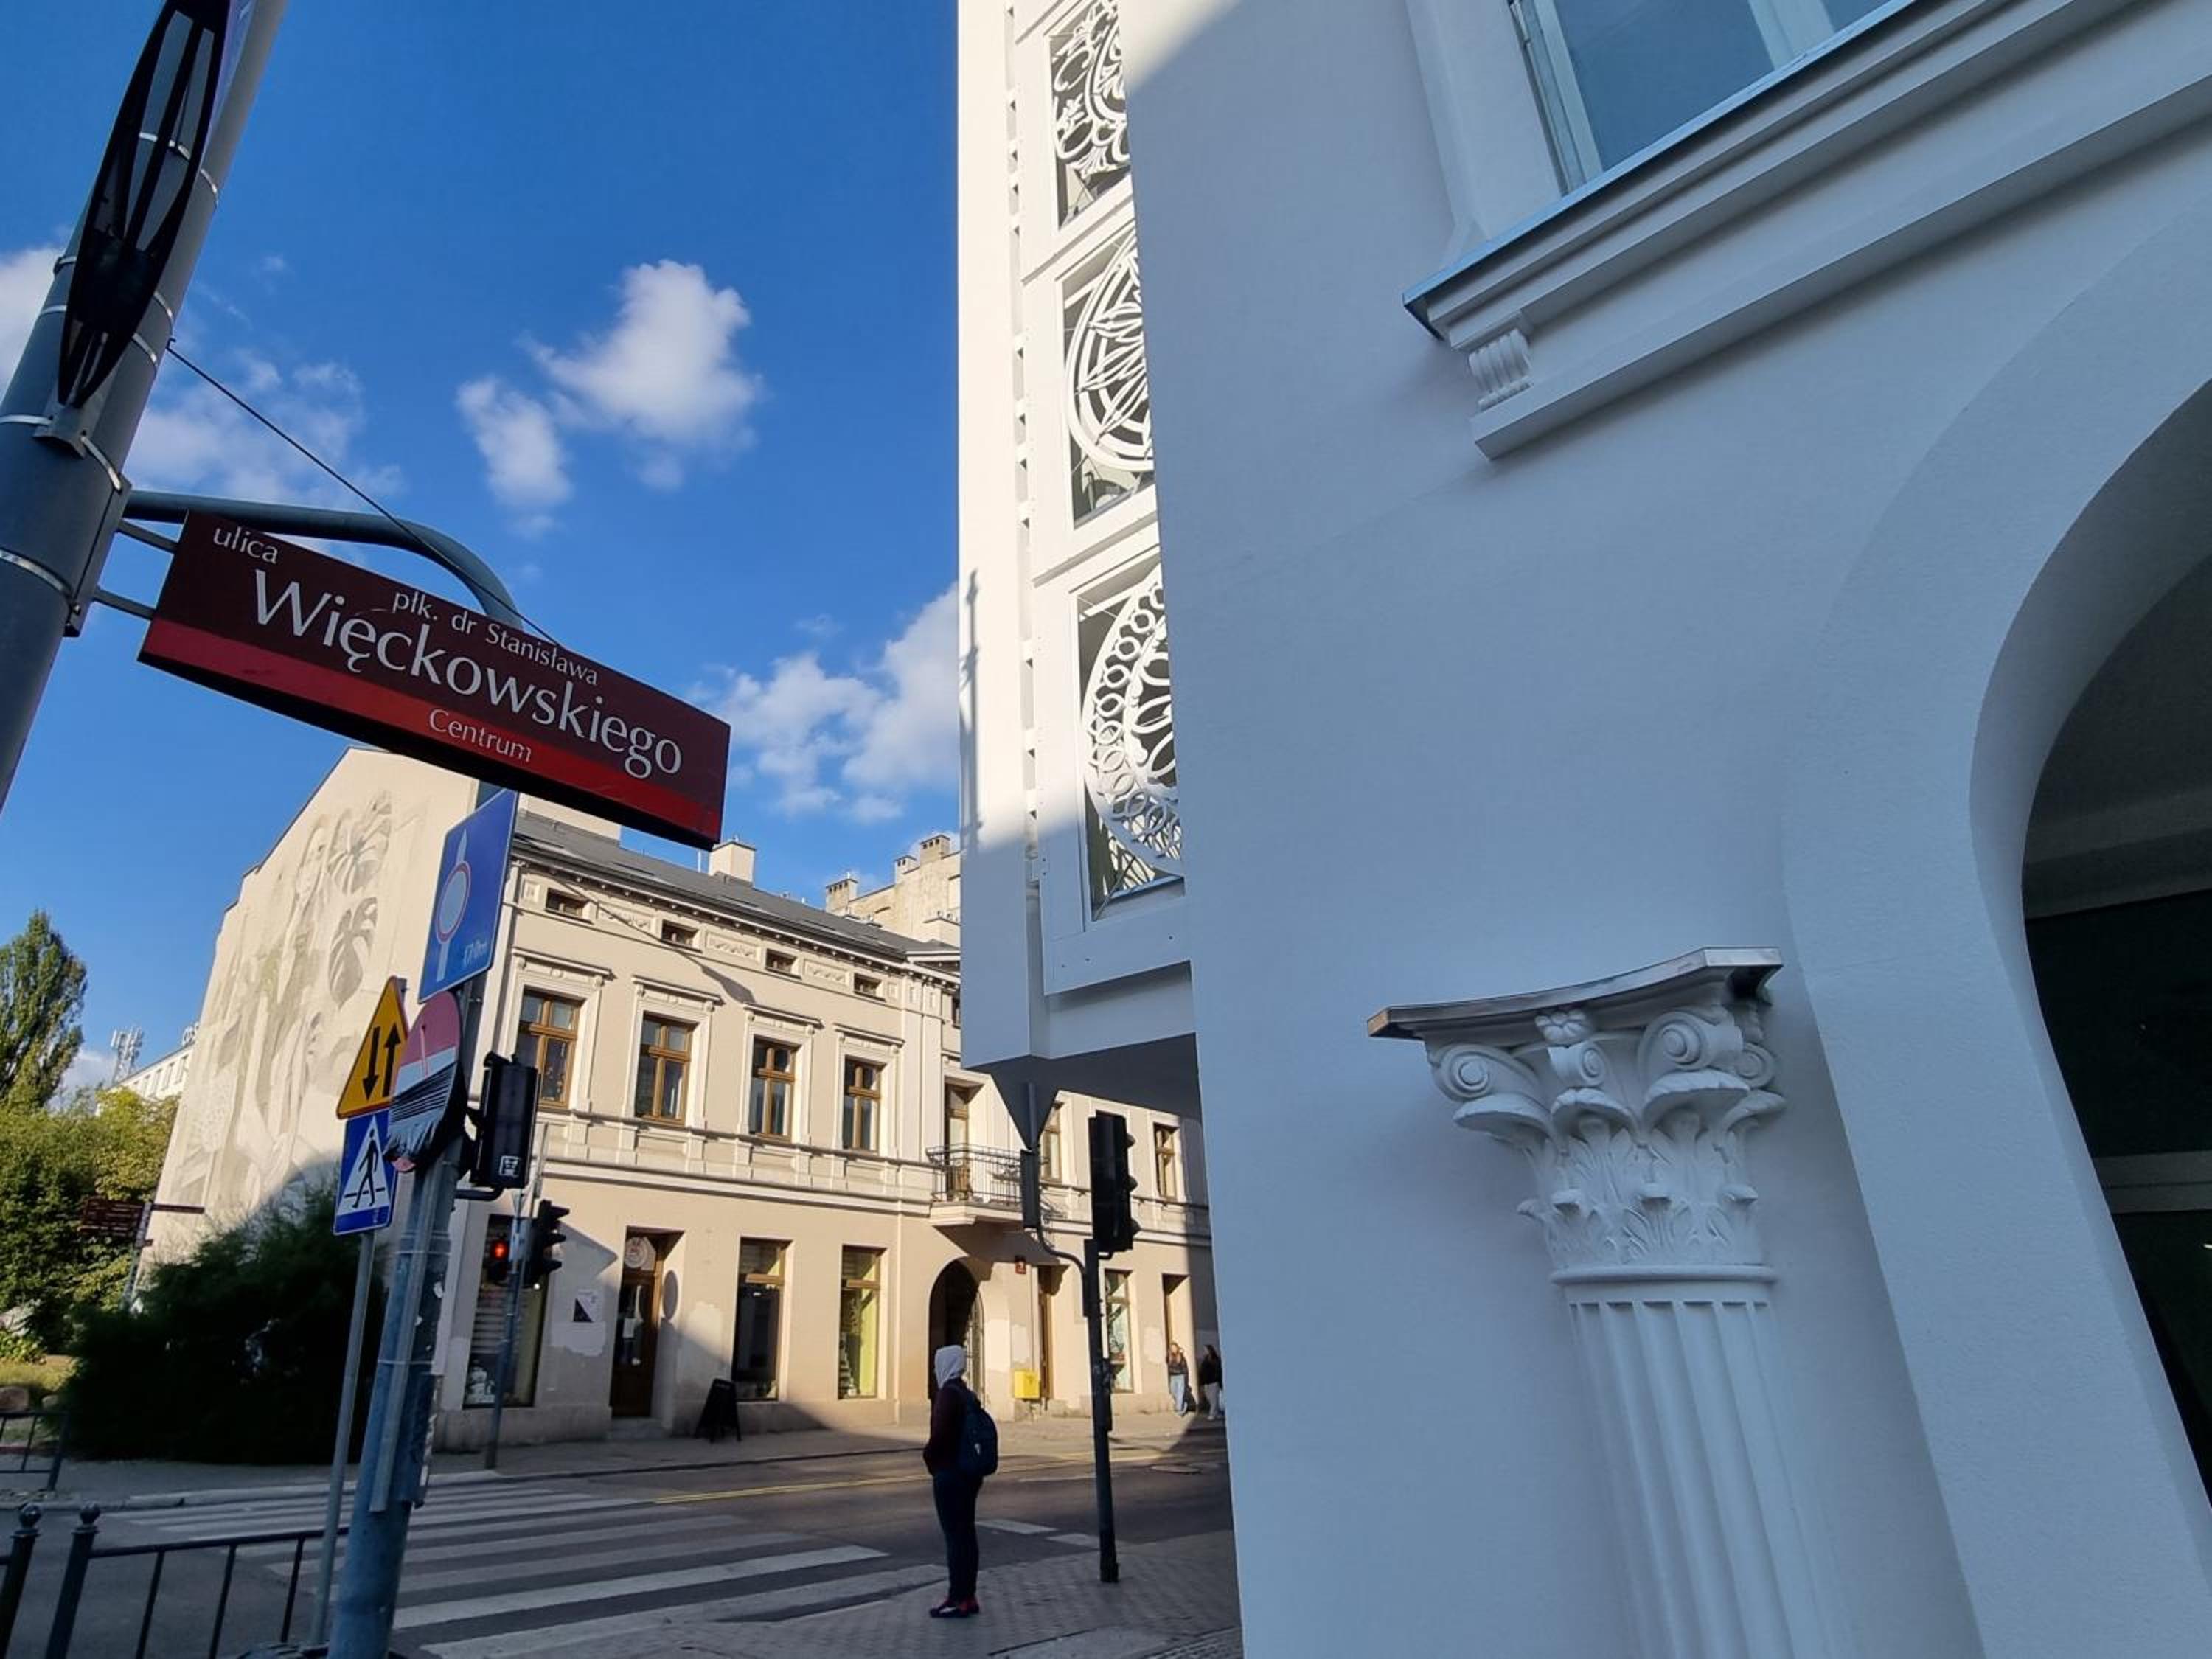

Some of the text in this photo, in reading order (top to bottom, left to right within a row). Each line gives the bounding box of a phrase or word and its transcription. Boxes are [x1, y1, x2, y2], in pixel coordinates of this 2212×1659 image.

[212, 526, 279, 565] ulica
[255, 568, 683, 779] Więckowskiego
[392, 591, 598, 686] płk. dr Stanisława
[428, 709, 532, 763] Centrum
